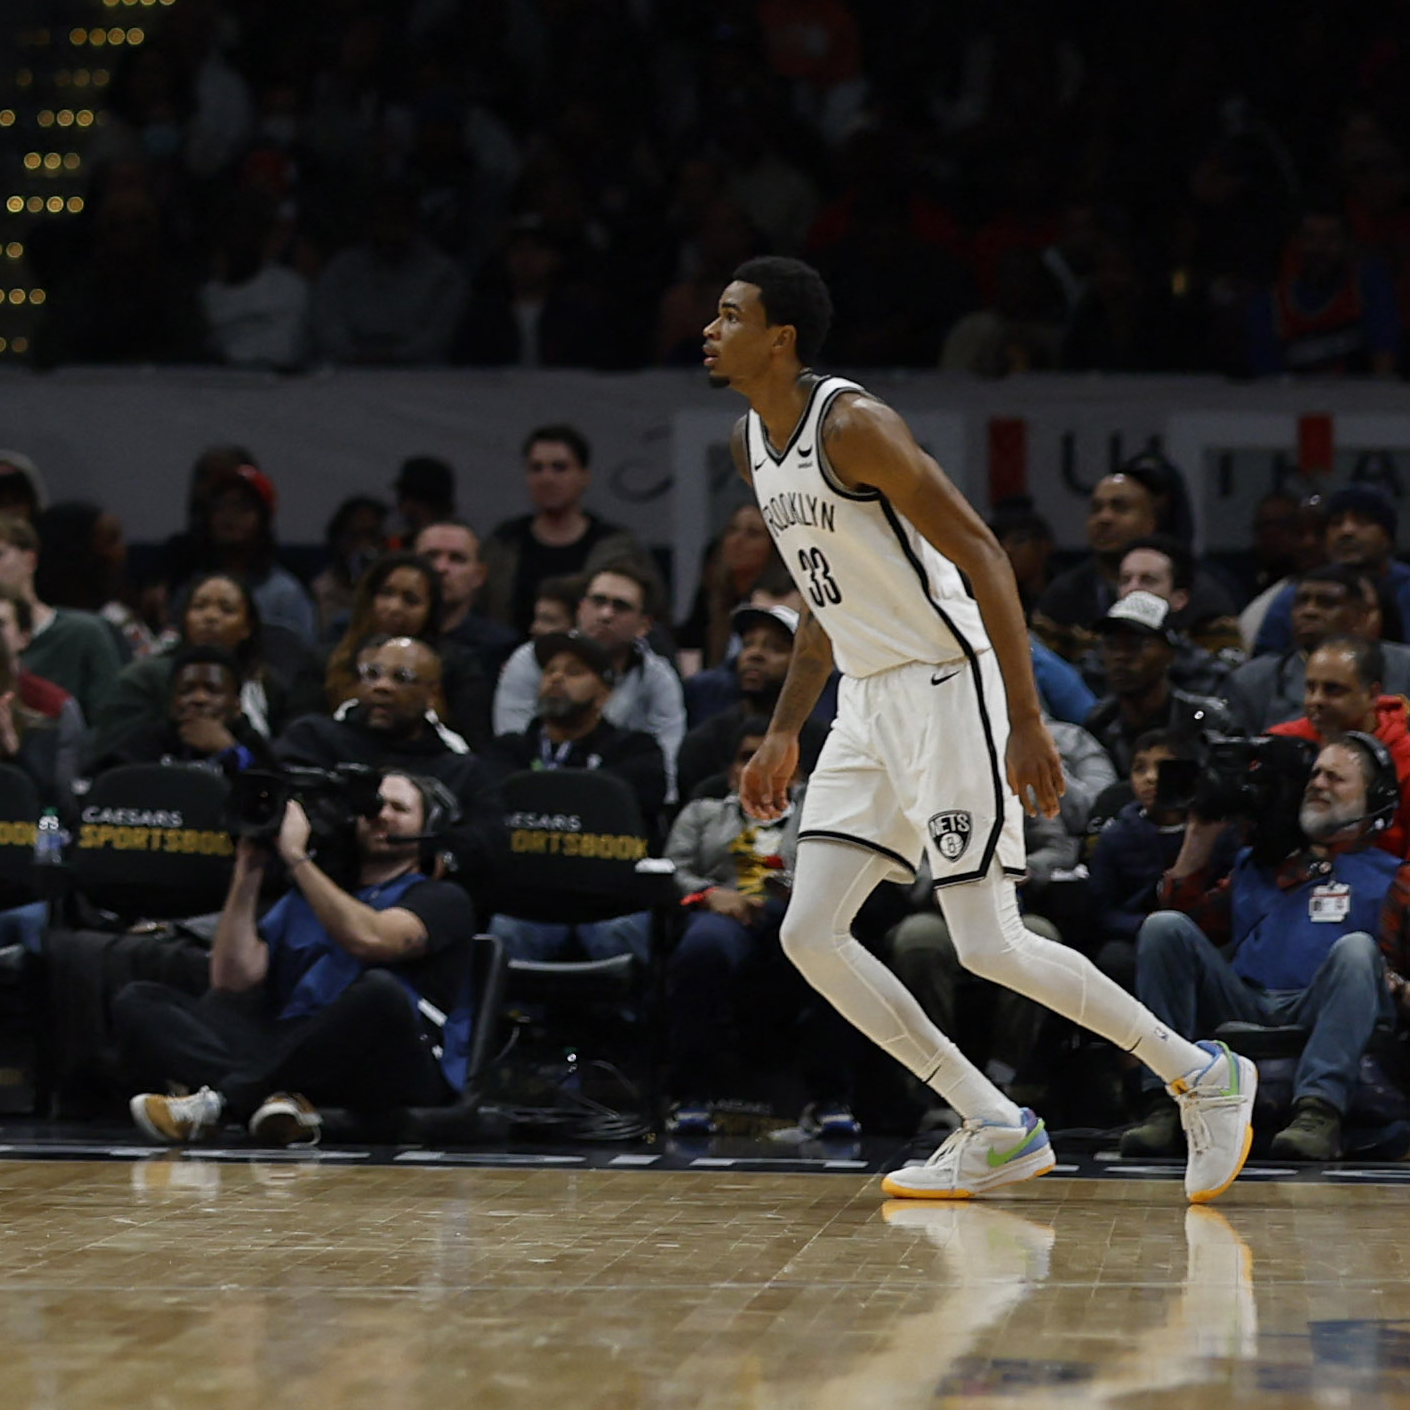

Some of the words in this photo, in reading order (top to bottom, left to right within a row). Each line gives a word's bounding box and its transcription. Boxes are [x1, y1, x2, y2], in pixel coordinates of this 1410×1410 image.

[798, 547, 842, 607] 33
[81, 805, 183, 828] CAESARS
[930, 814, 969, 838] NETS
